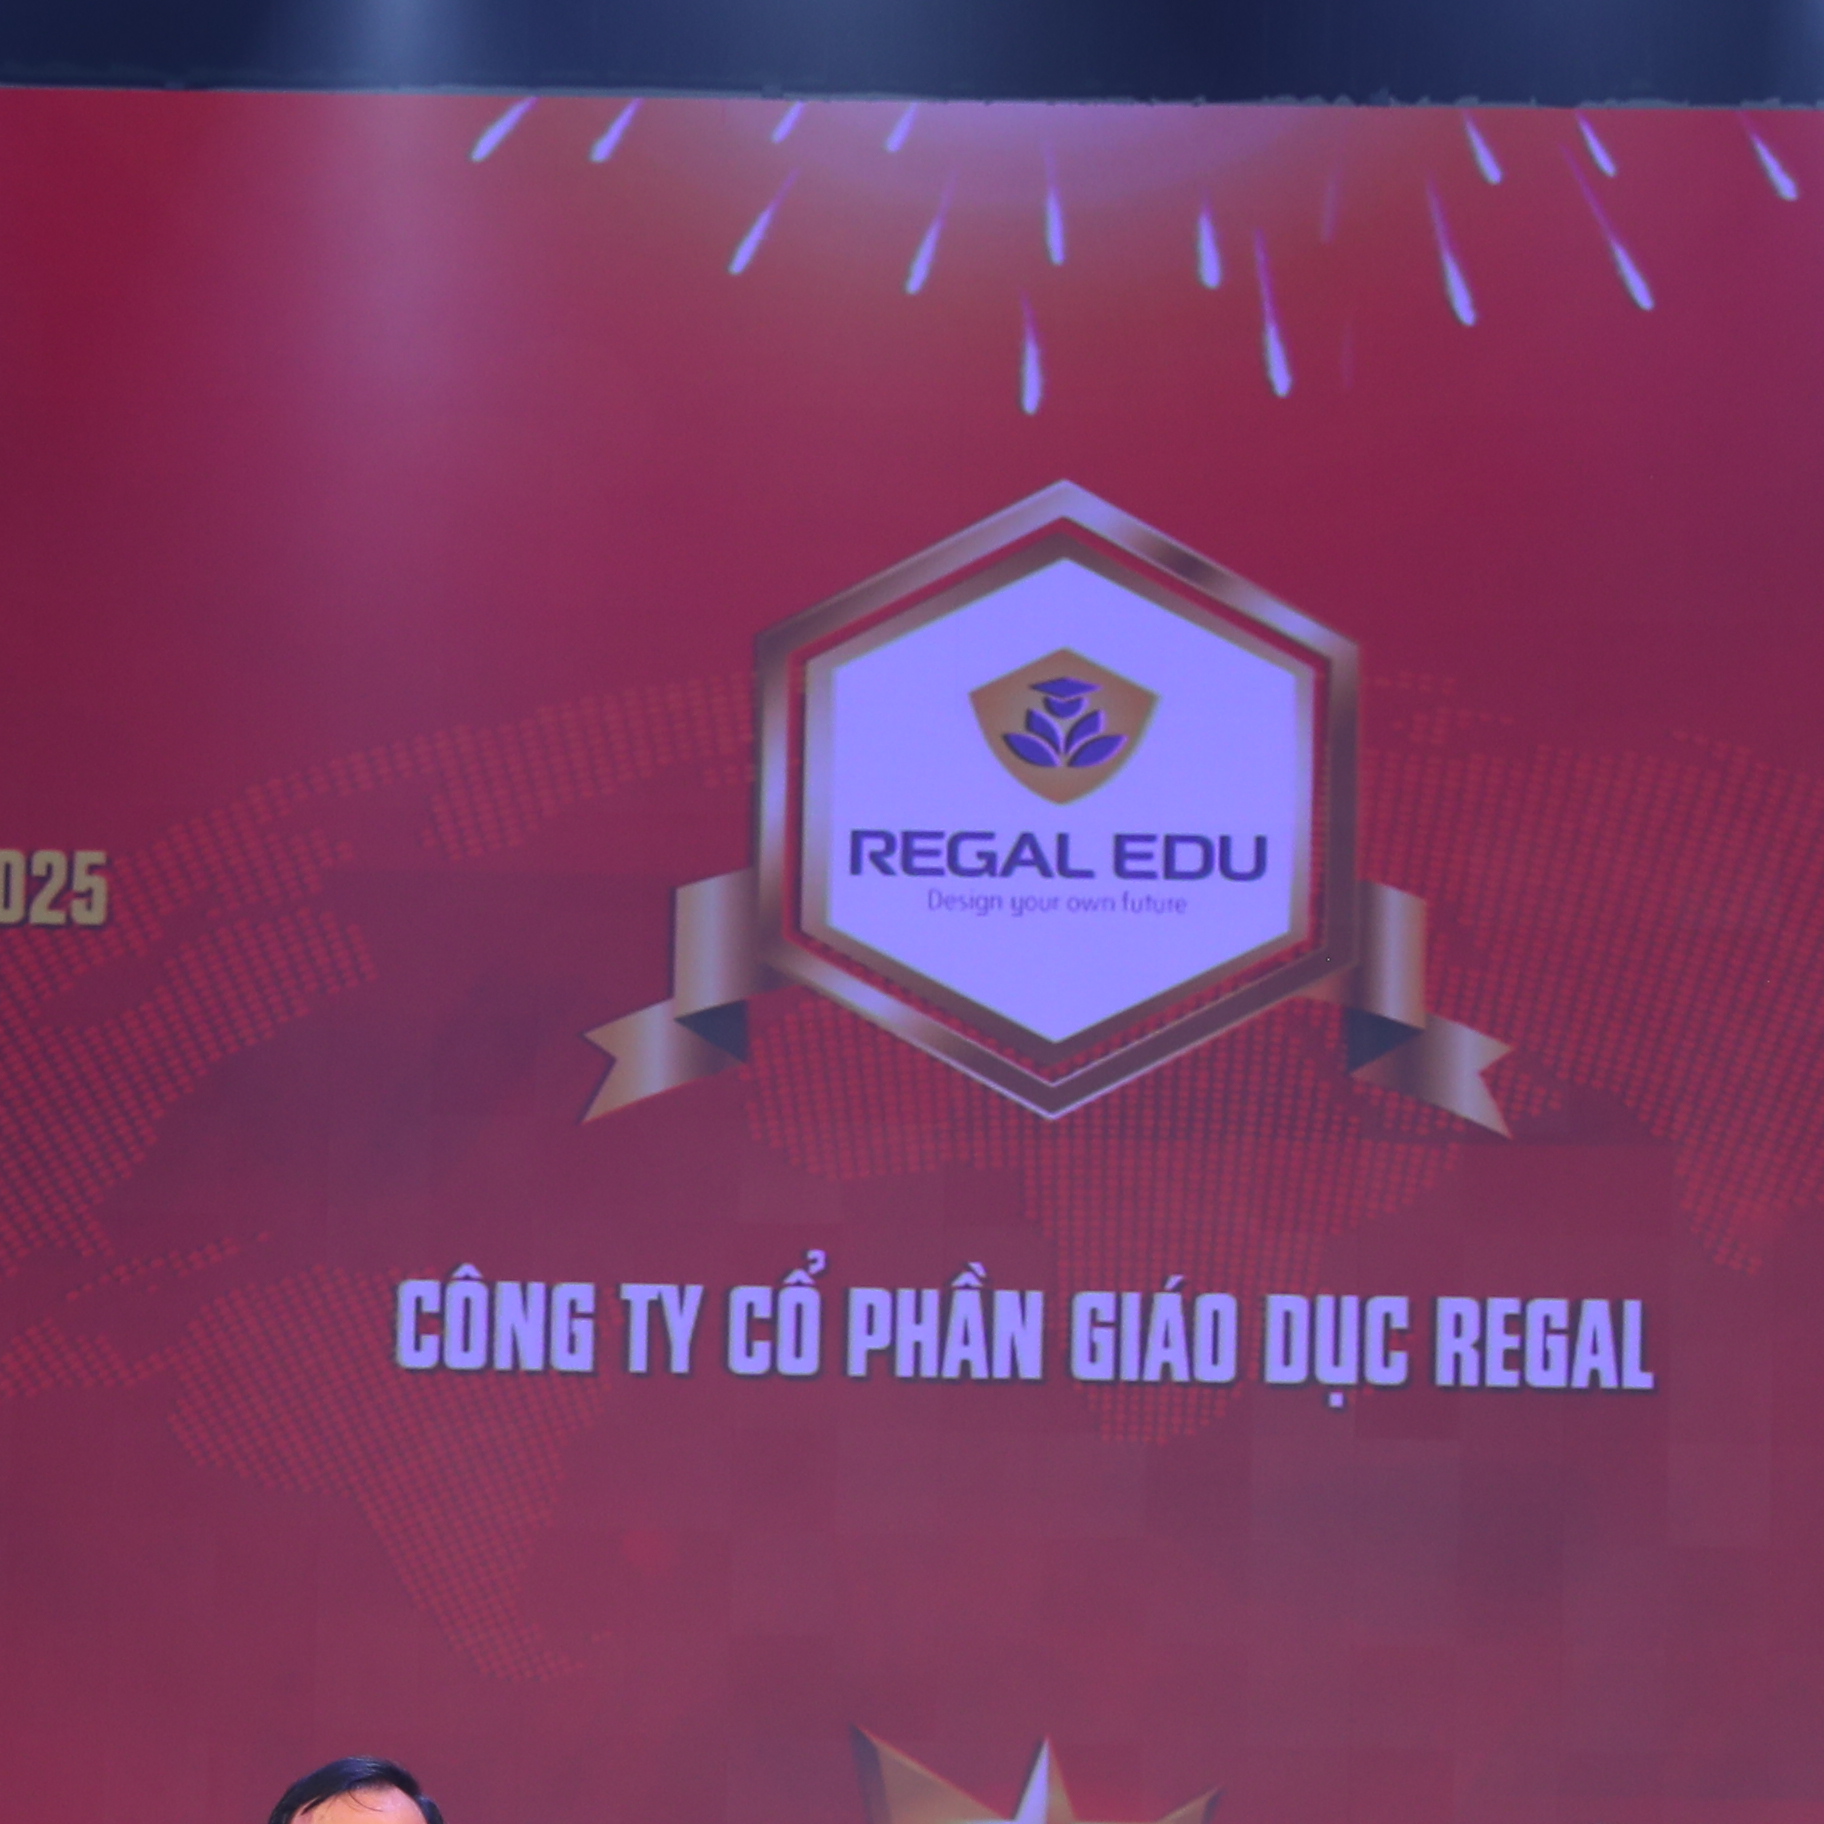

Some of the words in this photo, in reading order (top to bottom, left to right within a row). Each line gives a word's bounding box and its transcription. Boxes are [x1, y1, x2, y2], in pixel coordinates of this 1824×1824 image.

[849, 829, 1096, 879] REGAL
[1114, 833, 1268, 882] EDU
[927, 888, 1003, 916] Design
[1010, 891, 1060, 917] your
[1066, 894, 1116, 912] own
[1121, 891, 1188, 914] future
[396, 1263, 596, 1372] CÔNG
[620, 1283, 704, 1374] TY
[728, 1249, 827, 1376] CỔ
[847, 1261, 1044, 1380] PHẦN
[1071, 1275, 1237, 1383] GIÁO
[1265, 1293, 1408, 1407] DỤC
[1435, 1296, 1654, 1389] REGAL
